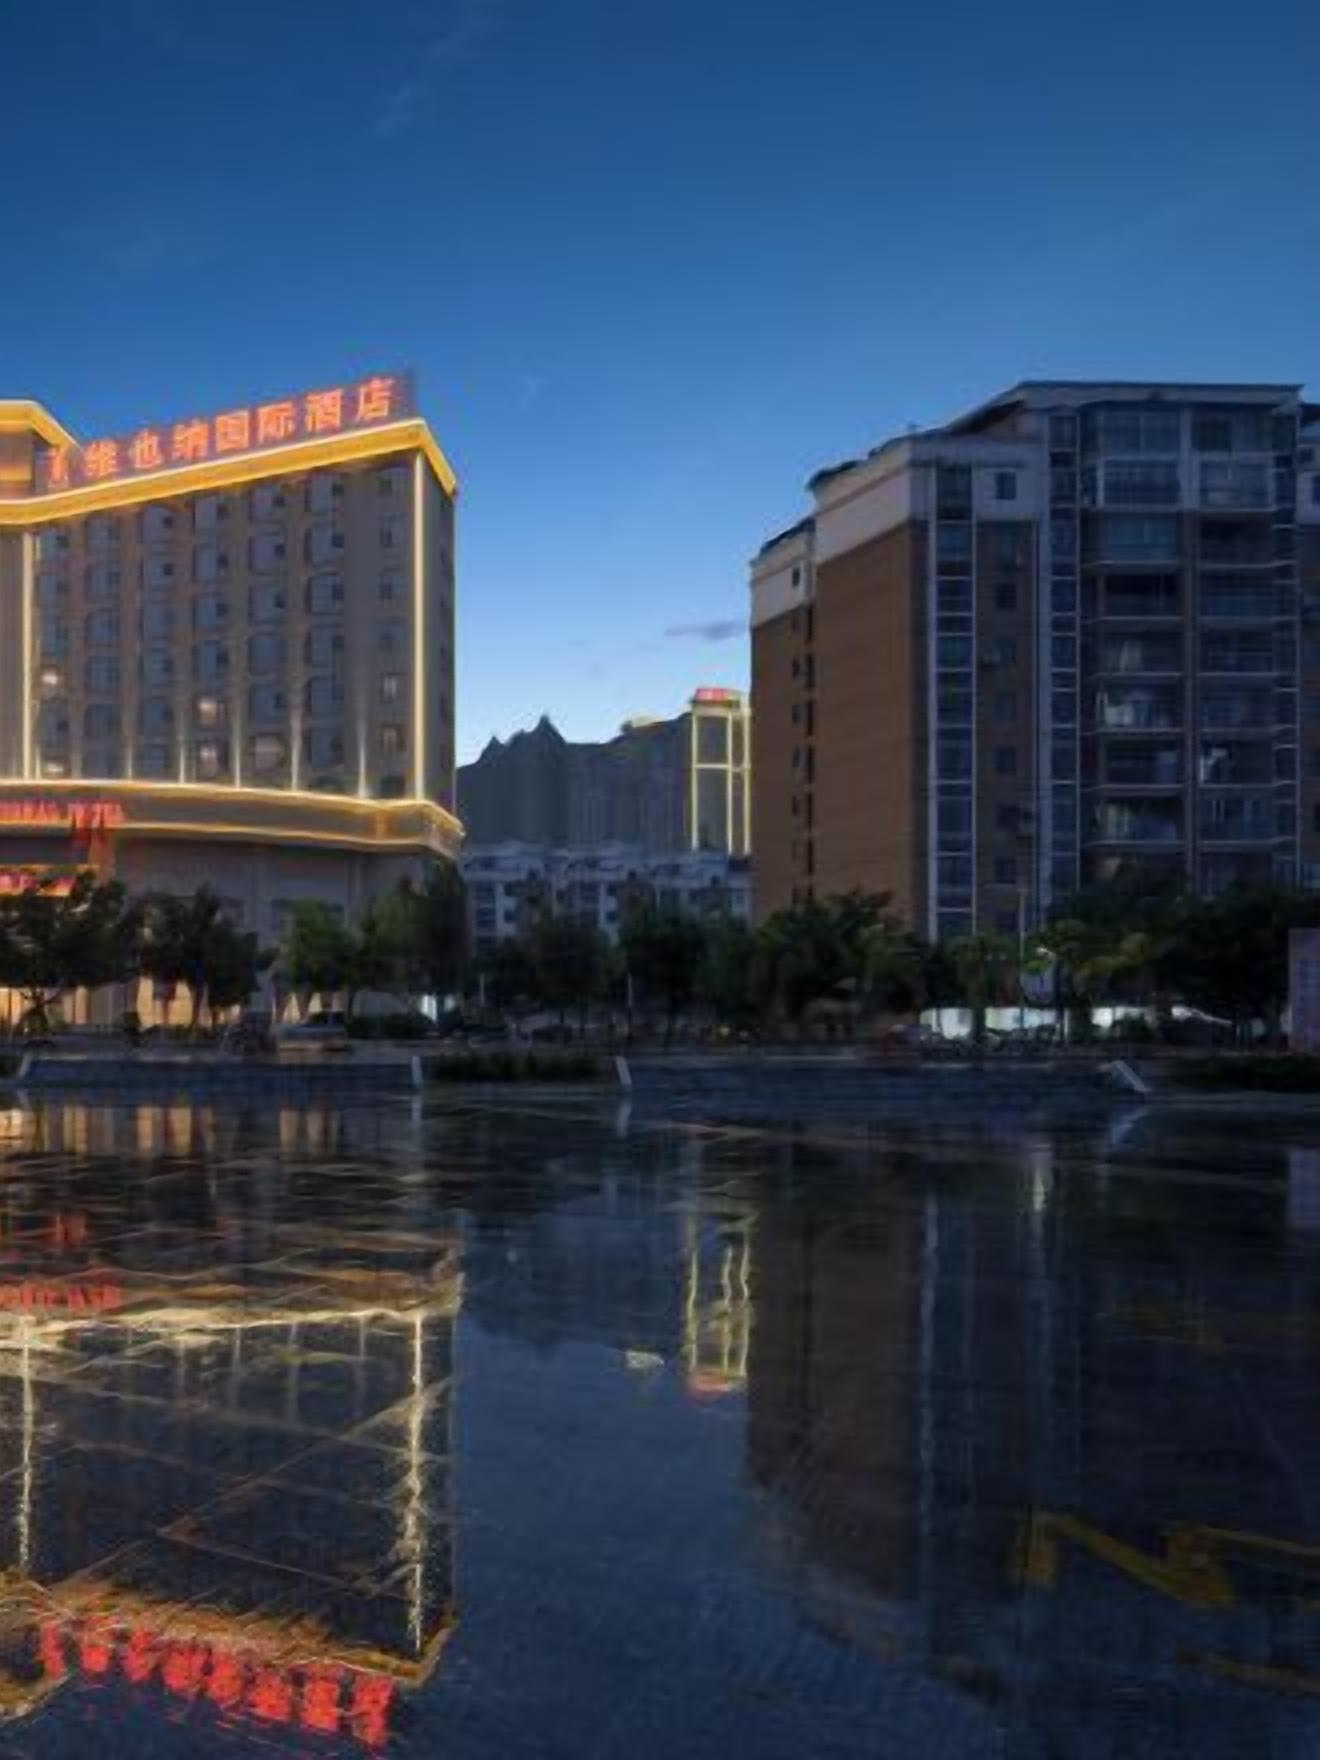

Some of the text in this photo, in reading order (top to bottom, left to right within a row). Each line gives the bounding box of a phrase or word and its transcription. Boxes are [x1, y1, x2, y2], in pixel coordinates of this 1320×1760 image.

[82, 376, 395, 478] 维也纳国际酒店
